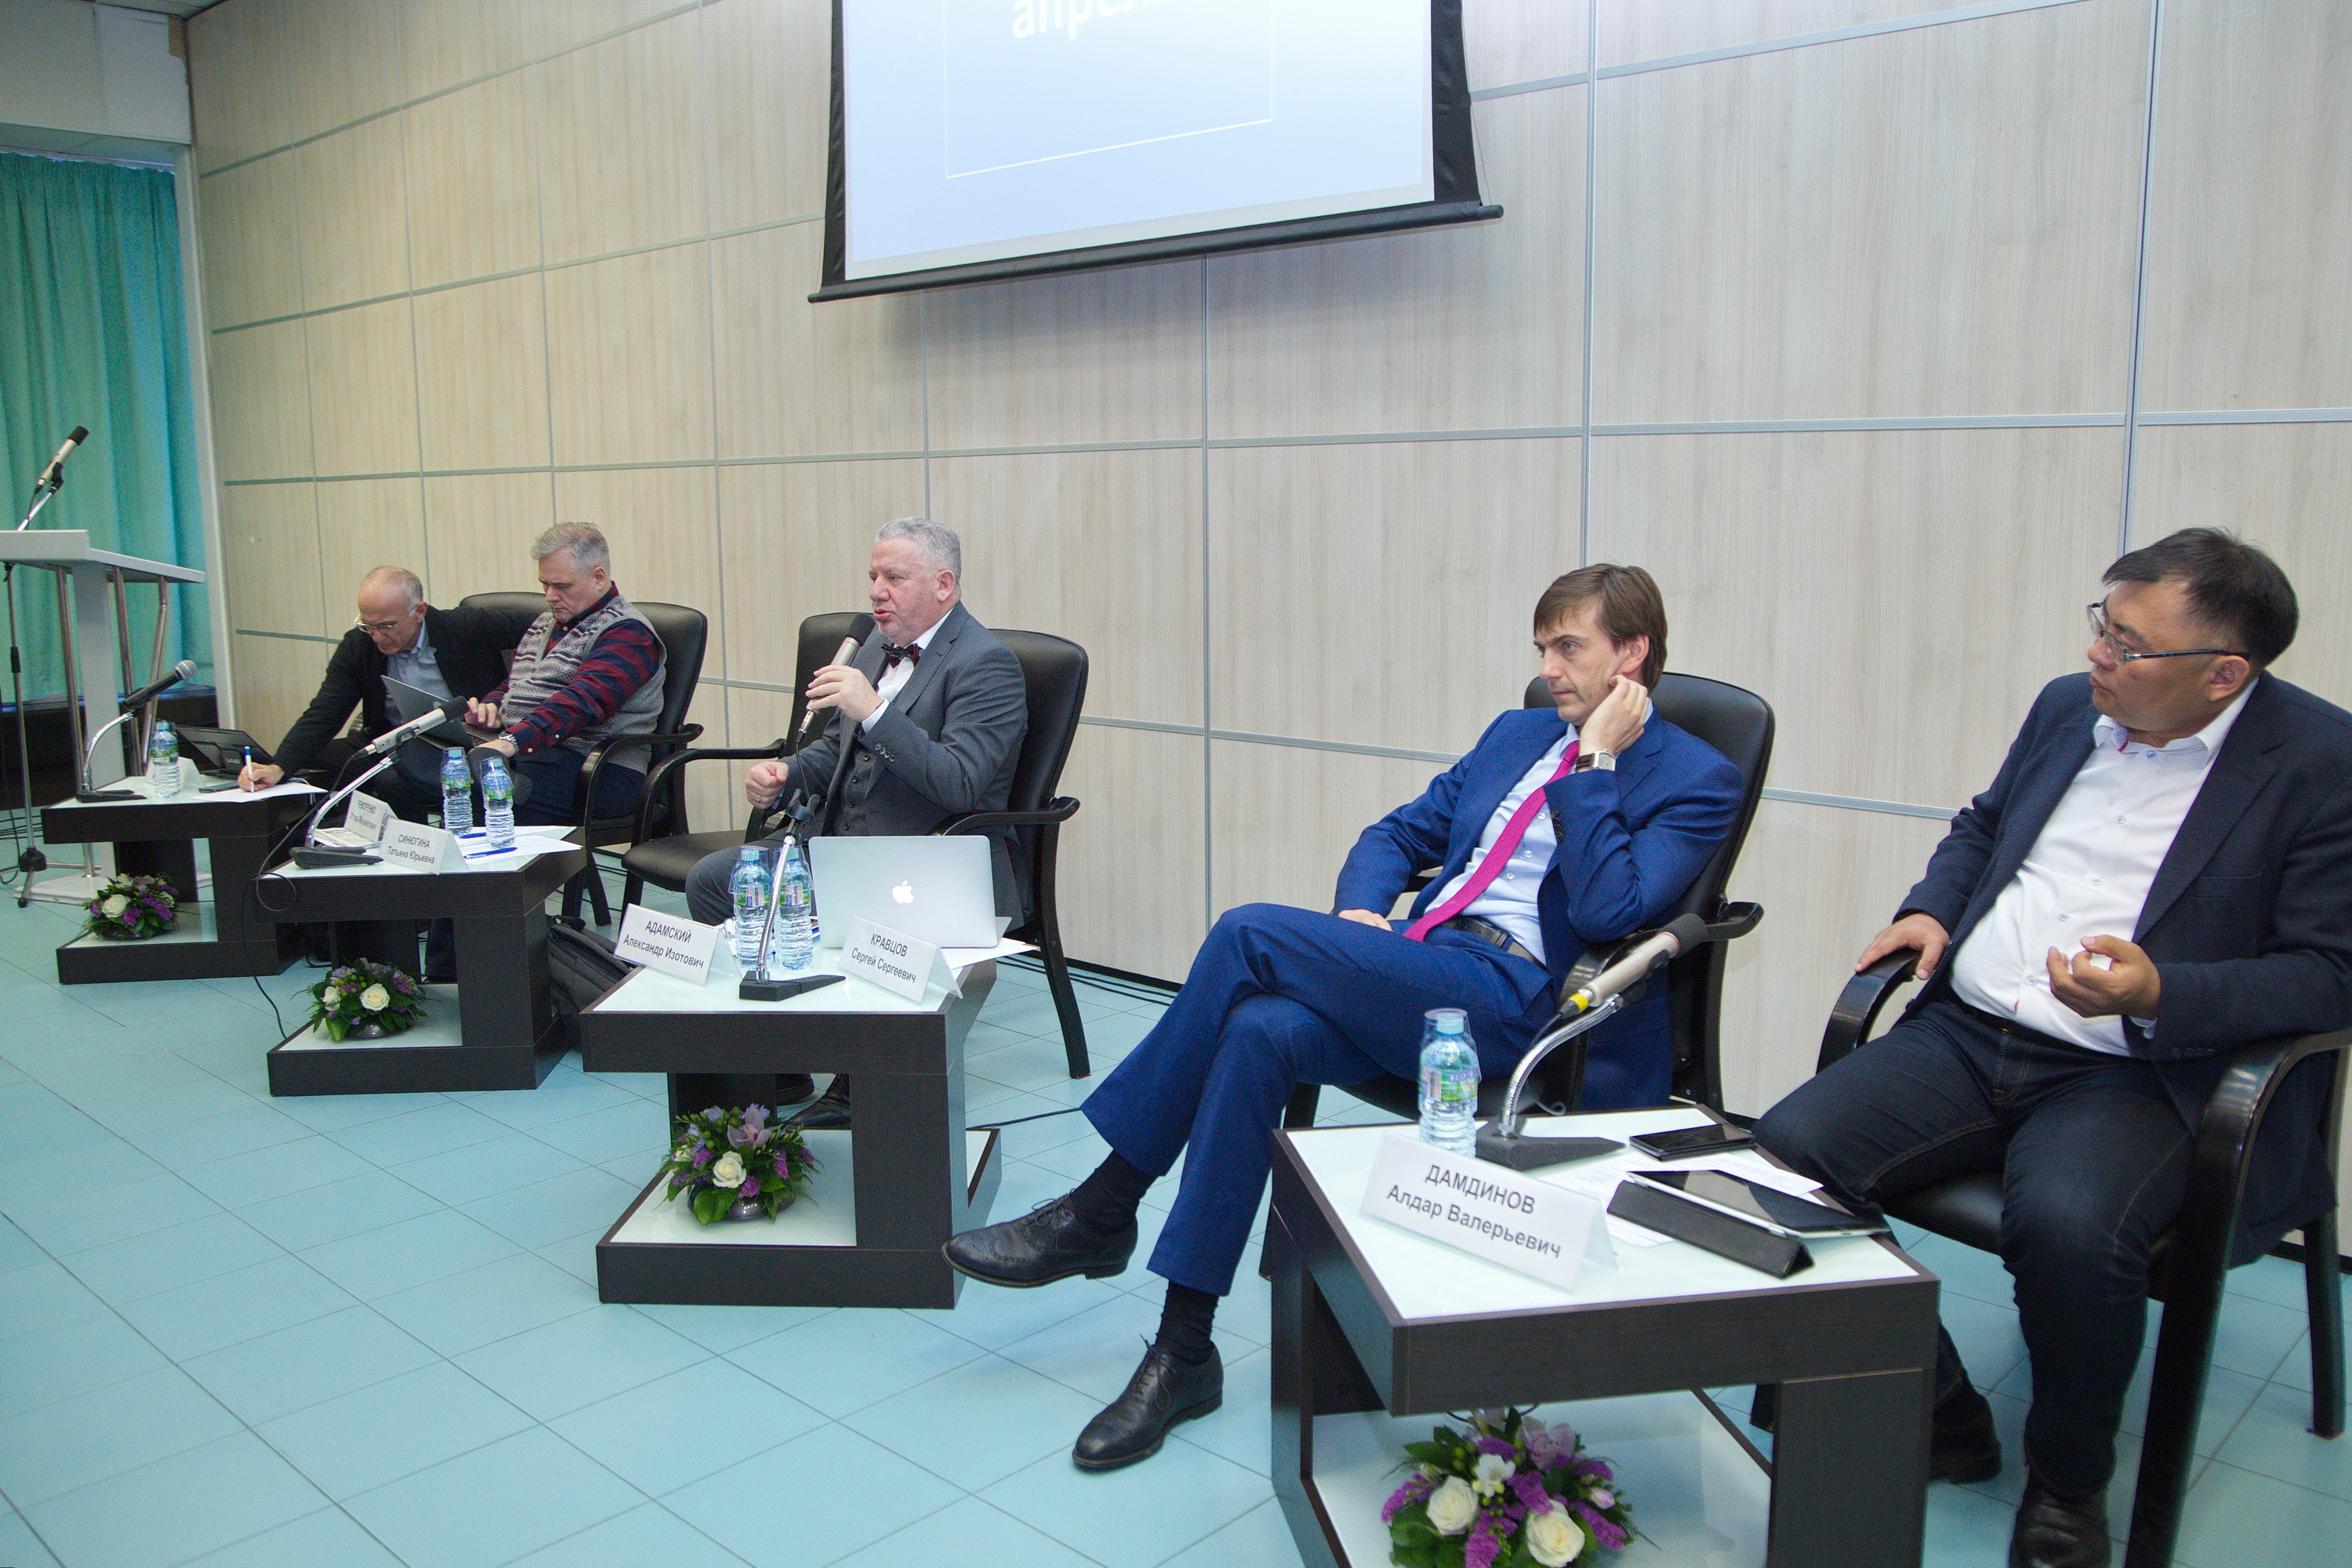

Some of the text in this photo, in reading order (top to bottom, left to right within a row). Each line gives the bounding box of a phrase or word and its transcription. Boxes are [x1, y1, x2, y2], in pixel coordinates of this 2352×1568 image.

[387, 845, 435, 864] Татьяна Юрьевна
[397, 833, 430, 849] СИНЮГИНА
[644, 920, 692, 944] АДАМСКИЙ
[870, 933, 908, 957] КРАВЦОВ
[623, 934, 705, 969] Александр Изотович
[851, 947, 916, 983] Сергей Сергеевич
[1425, 1164, 1536, 1214] ДАМДИНОВ
[1387, 1185, 1562, 1258] Алдар Валерьевич
